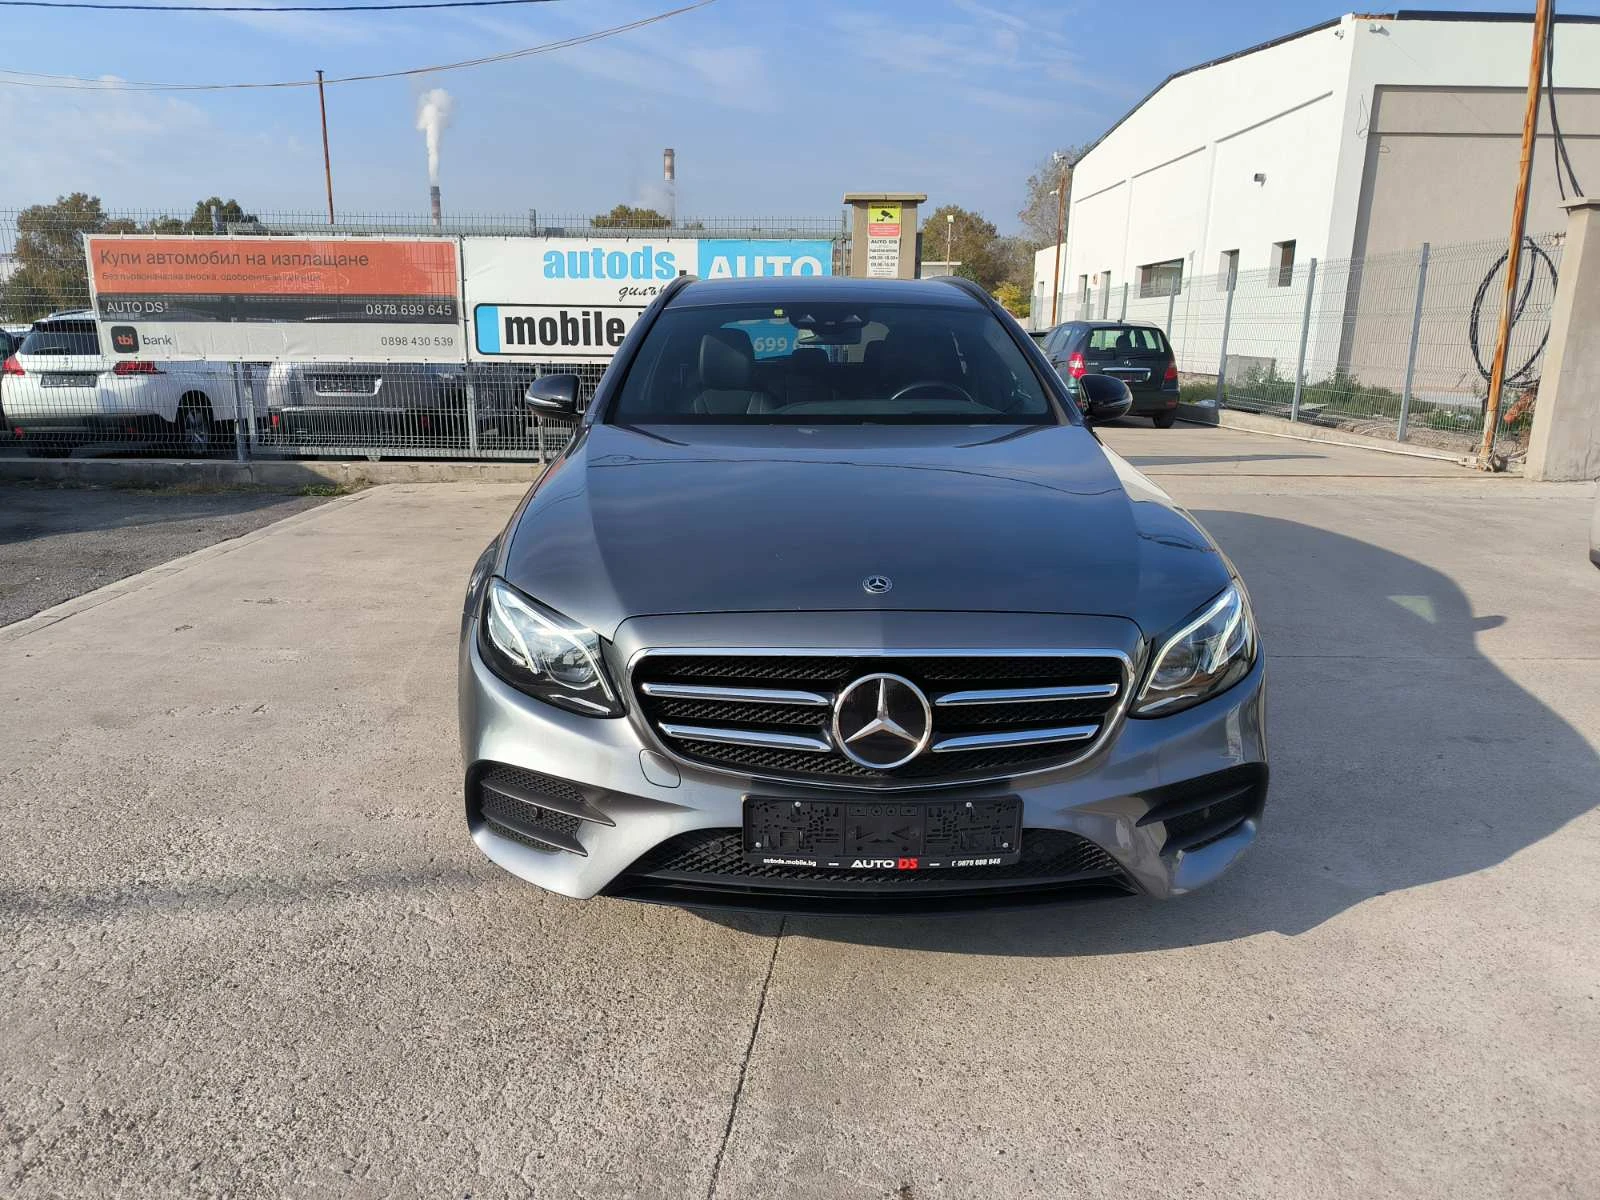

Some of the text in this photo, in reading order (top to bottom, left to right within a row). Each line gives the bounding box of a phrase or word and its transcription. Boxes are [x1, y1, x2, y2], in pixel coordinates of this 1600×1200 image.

[100, 249, 369, 269] Купи автомобил на изплащане
[707, 255, 823, 280] AUTO
[106, 301, 142, 313] AUTO
[365, 303, 452, 316] 0878 699 645
[116, 333, 173, 346] tbi bank
[380, 336, 454, 347] 0898 430 539
[753, 336, 788, 352] 699
[850, 858, 918, 869] AUTO DS
